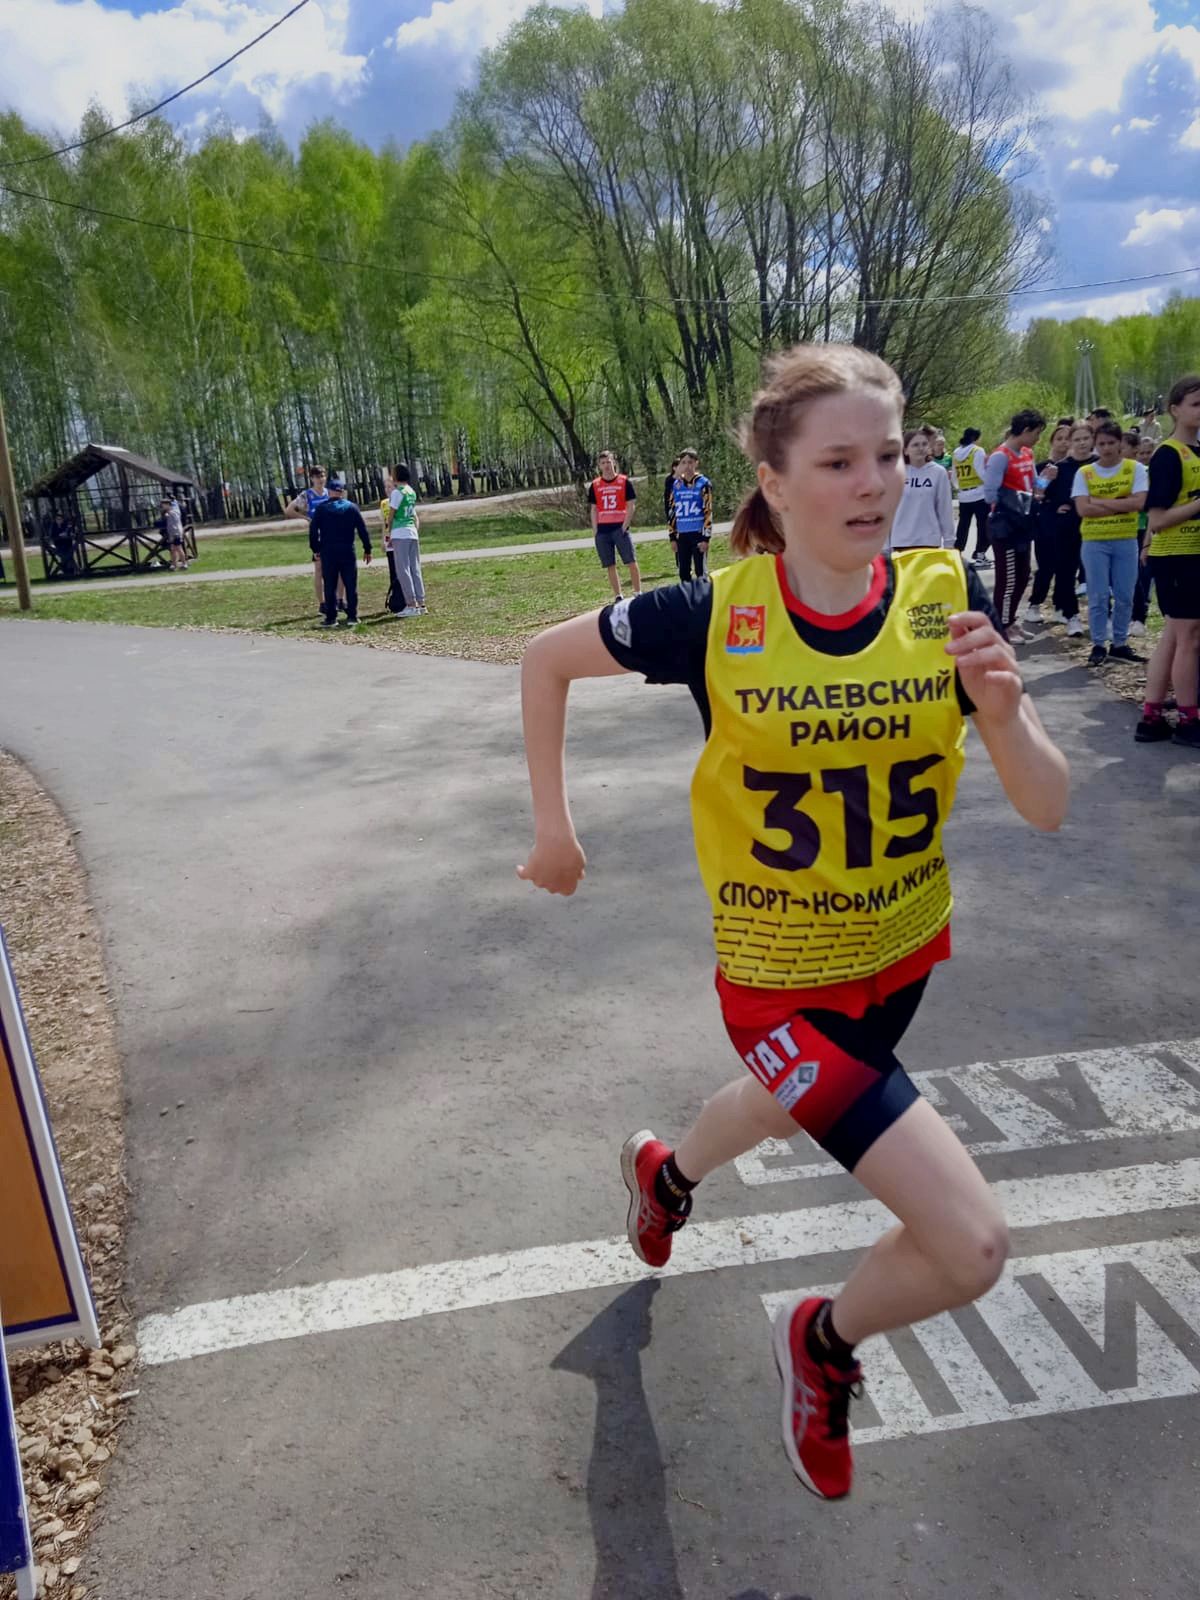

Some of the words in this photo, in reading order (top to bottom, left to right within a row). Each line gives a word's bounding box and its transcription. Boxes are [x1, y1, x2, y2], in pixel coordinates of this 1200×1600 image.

[904, 478, 933, 488] ILA
[602, 495, 617, 509] 13
[675, 500, 701, 517] 214
[909, 615, 947, 628] НОРМ
[735, 669, 952, 714] ТУКАЕВСКИЙ
[790, 711, 911, 747] РАЙОН
[743, 753, 946, 872] 315
[719, 881, 792, 914] СПОРТ
[813, 880, 898, 915] НОРМА
